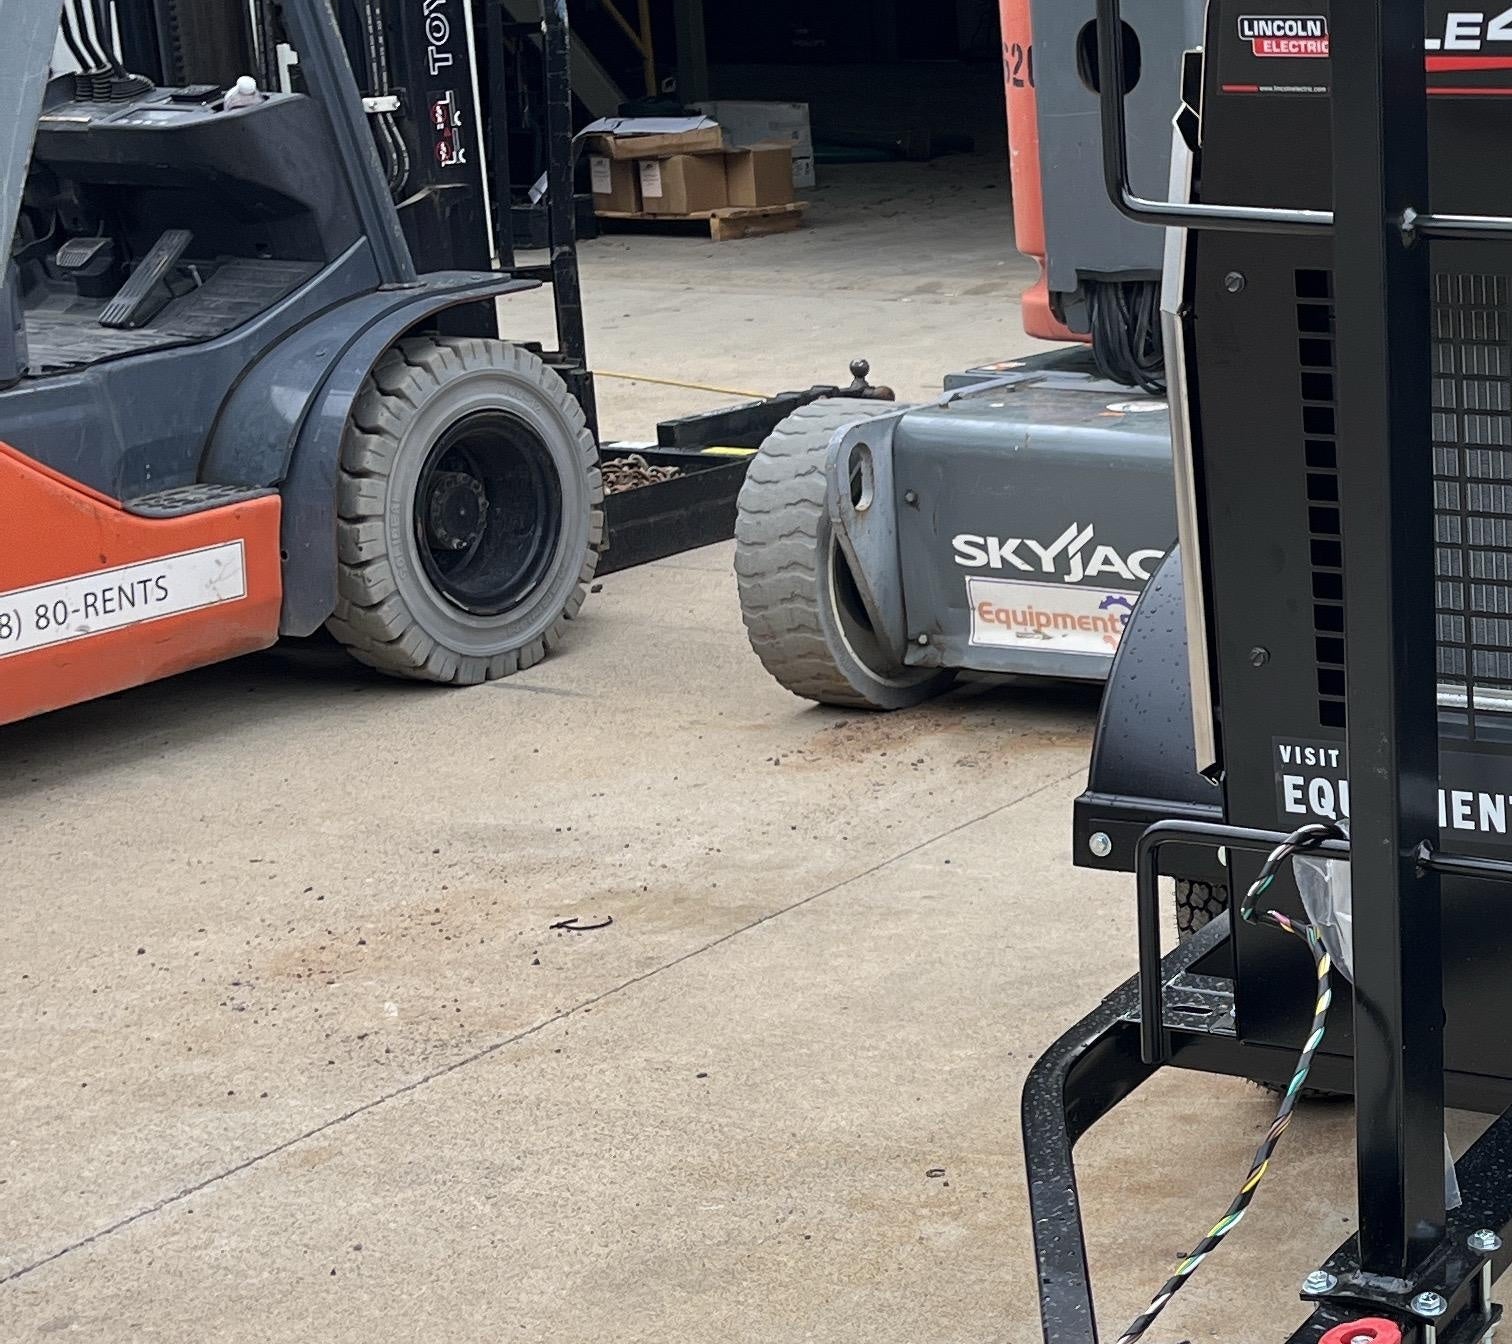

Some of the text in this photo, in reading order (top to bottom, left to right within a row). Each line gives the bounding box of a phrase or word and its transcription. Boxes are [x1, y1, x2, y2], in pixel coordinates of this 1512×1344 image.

[1244, 20, 1321, 36] LINCOLN
[952, 522, 1166, 583] SKYJAC
[35, 575, 169, 630] 80-RENTS
[1279, 745, 1339, 768] VISIT
